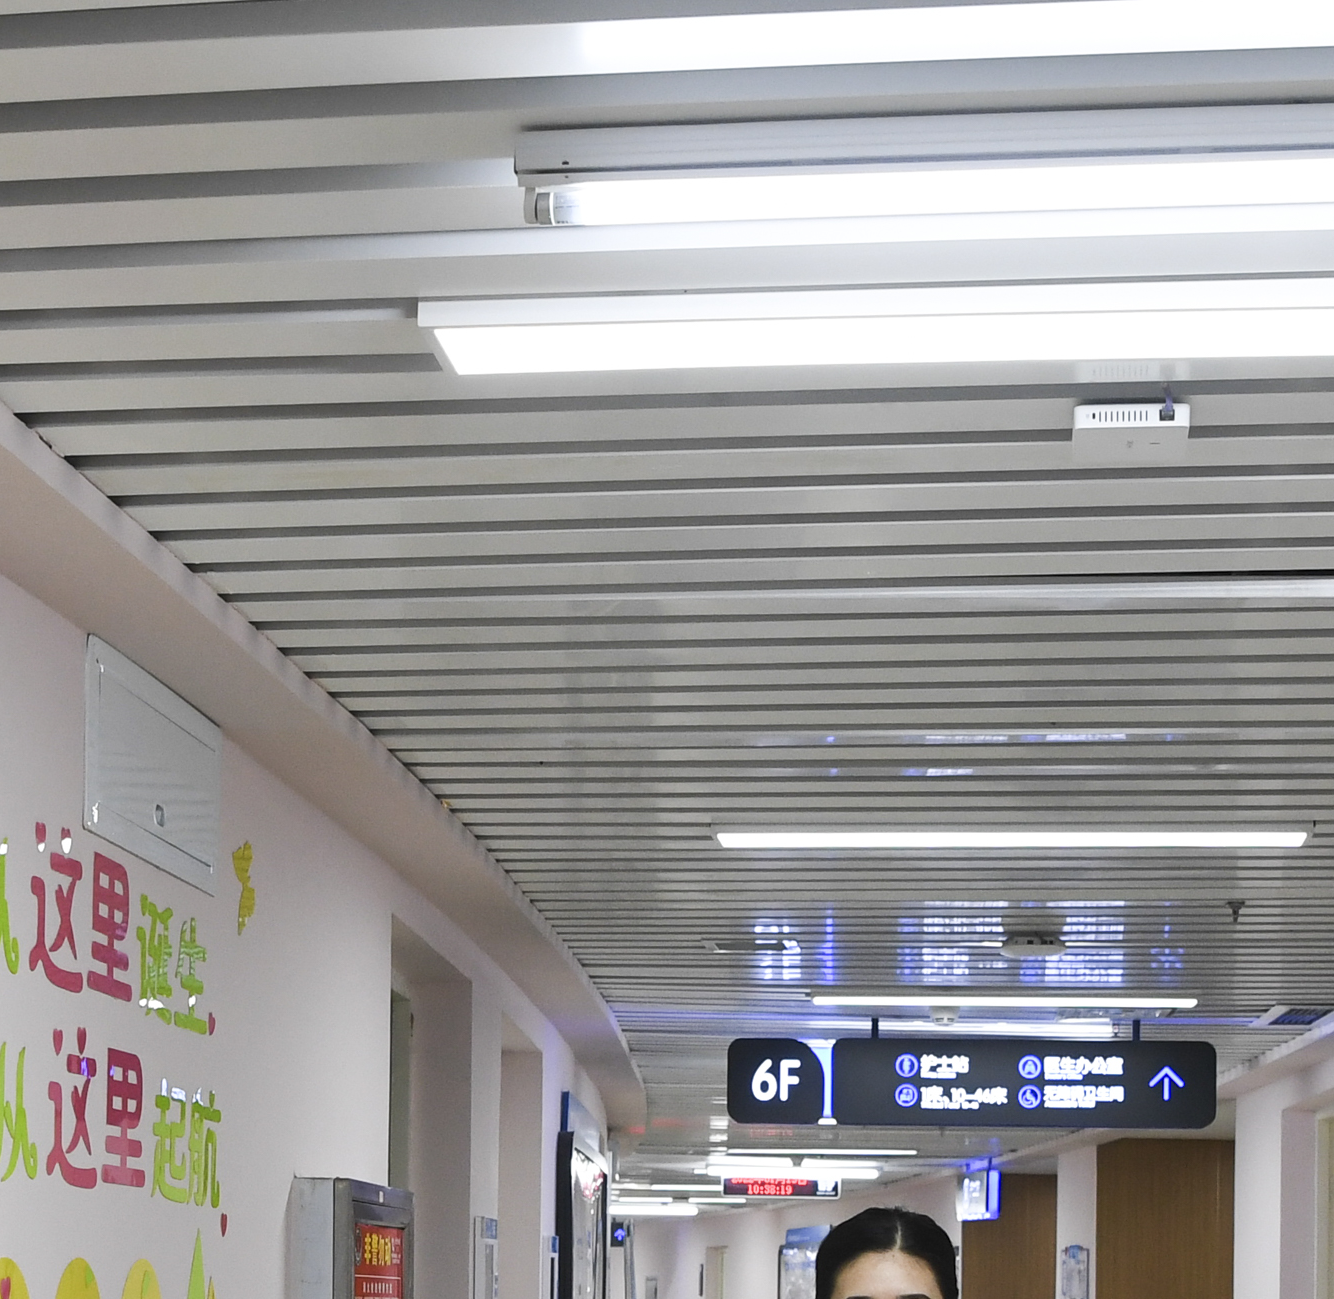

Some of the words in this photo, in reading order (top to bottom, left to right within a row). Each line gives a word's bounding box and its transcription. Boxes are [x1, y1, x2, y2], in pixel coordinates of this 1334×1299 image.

[921, 1055, 969, 1073] 护士站
[1044, 1057, 1123, 1074] 医生办公室
[751, 1058, 801, 1102] 6F
[1044, 1085, 1124, 1101] 无障碍卫生间
[364, 1233, 391, 1266] 非警勿动
